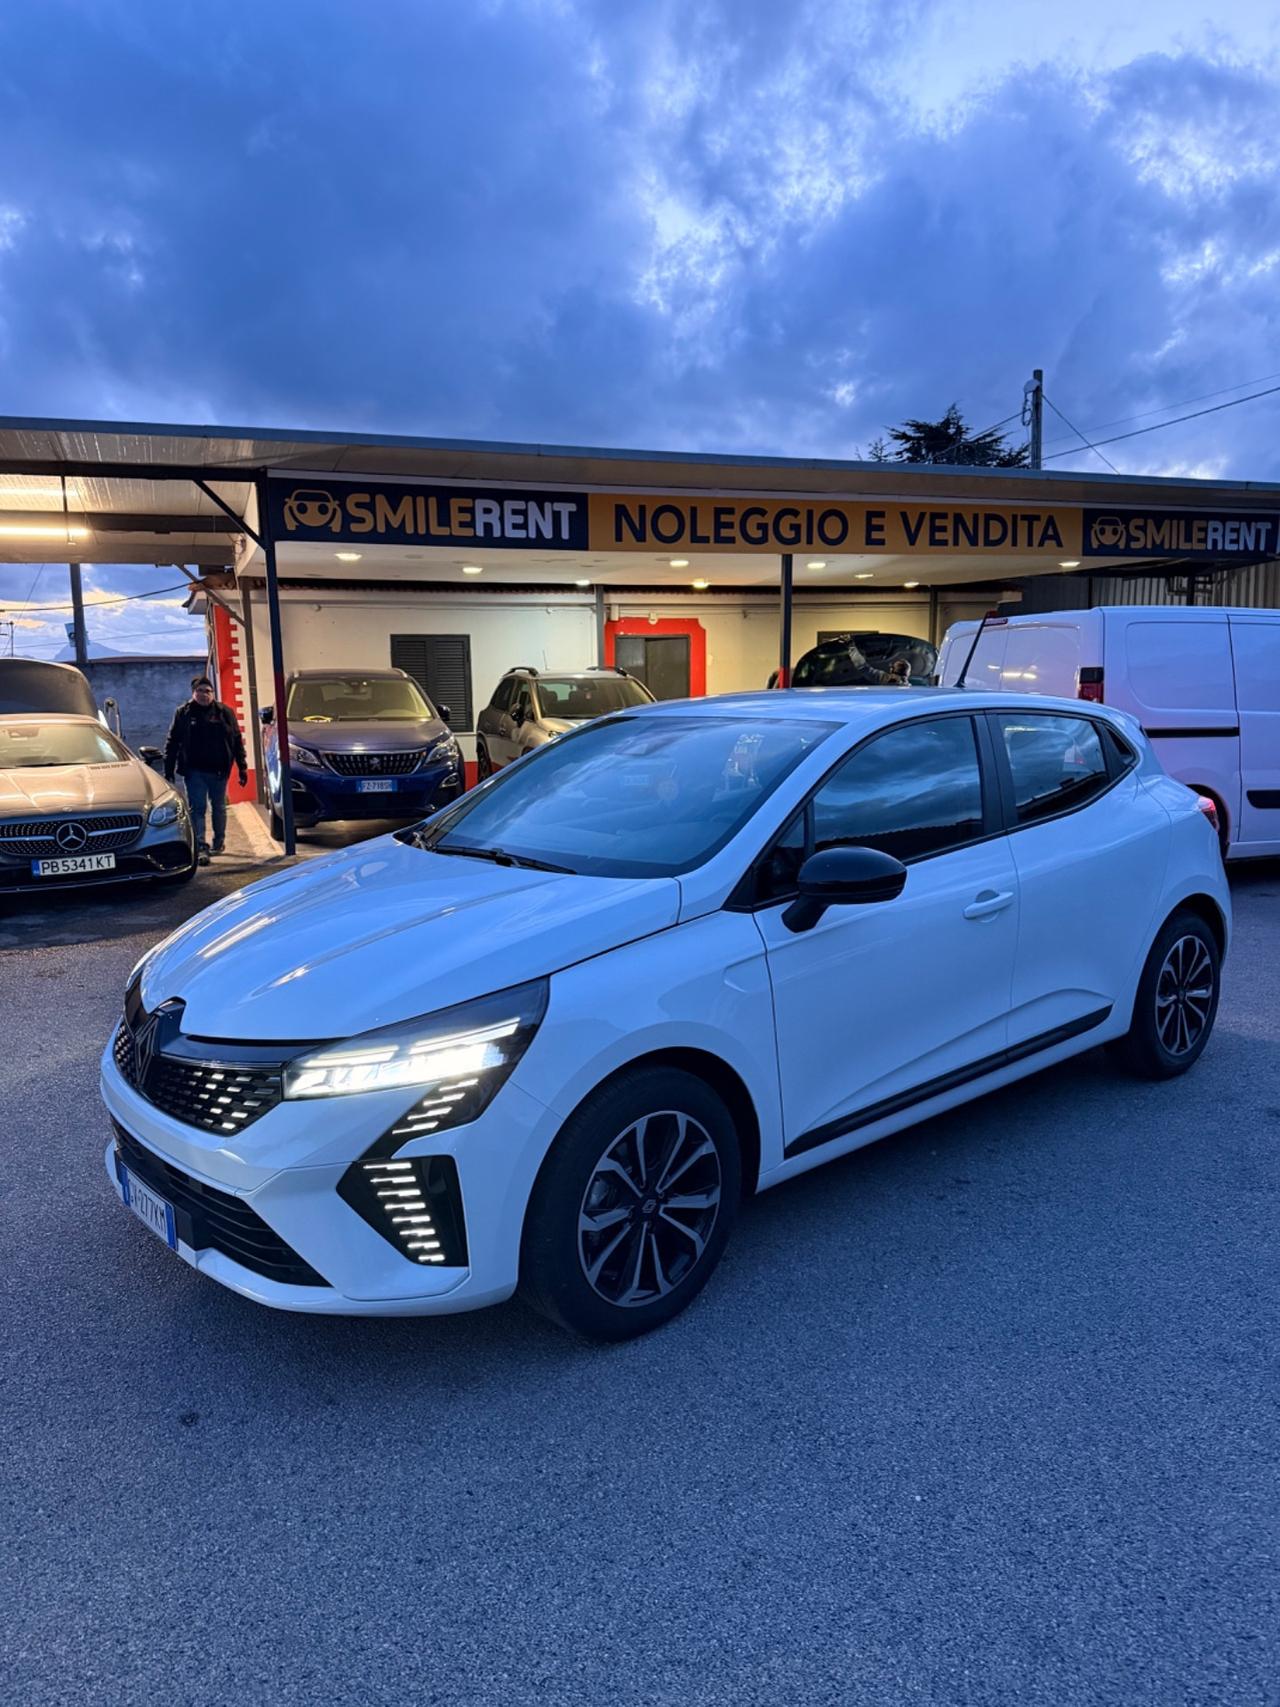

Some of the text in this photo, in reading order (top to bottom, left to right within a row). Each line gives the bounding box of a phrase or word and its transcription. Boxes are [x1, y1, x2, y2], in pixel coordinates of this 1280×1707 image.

[346, 493, 577, 540] SMILERENT
[614, 503, 1064, 548] NOLEGGIO E VENDITA
[1129, 518, 1272, 551] SMILERENT
